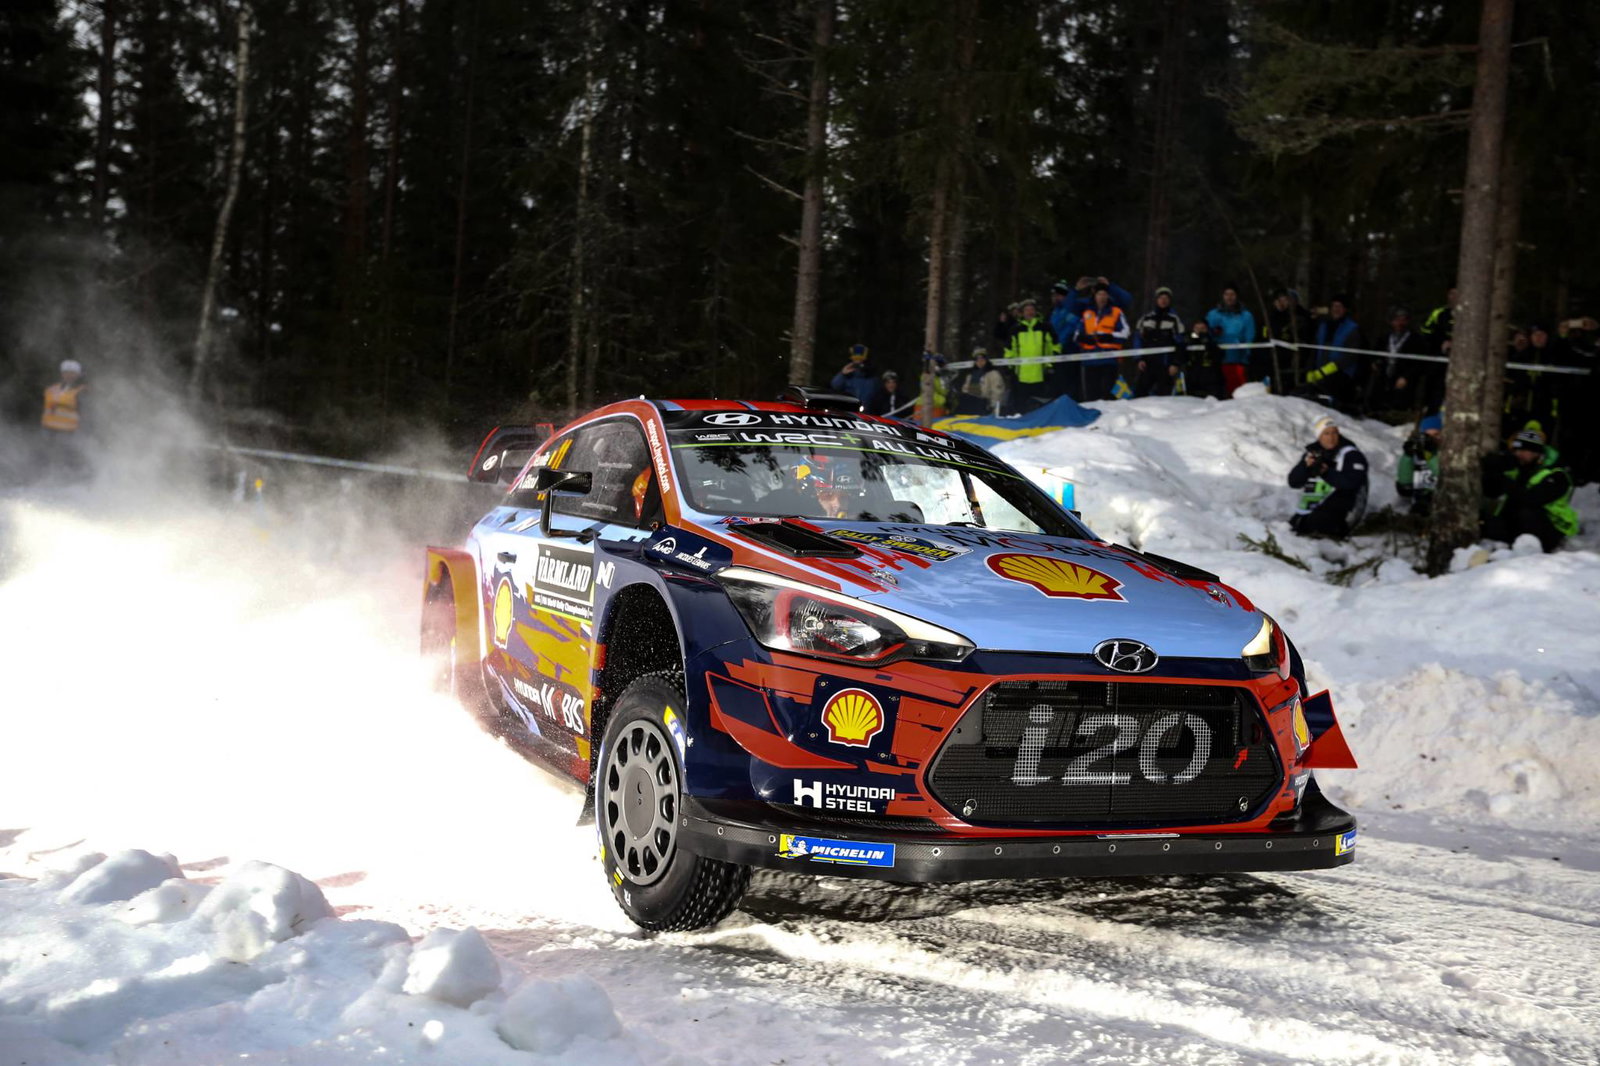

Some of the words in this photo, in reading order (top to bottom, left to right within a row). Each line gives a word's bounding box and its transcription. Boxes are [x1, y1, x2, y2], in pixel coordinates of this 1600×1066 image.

[769, 414, 902, 437] HYUNDAI
[871, 439, 916, 454] ALL
[916, 446, 968, 465] LIVE
[832, 528, 879, 543] RALLY
[881, 538, 955, 559] SWEDEN
[942, 533, 1138, 563] MOBIS
[541, 682, 585, 735] MOBIS
[1010, 694, 1213, 786] i20
[825, 783, 896, 800] HYUNDAI
[825, 797, 876, 813] STEEL
[810, 845, 885, 860] MICHELIN
